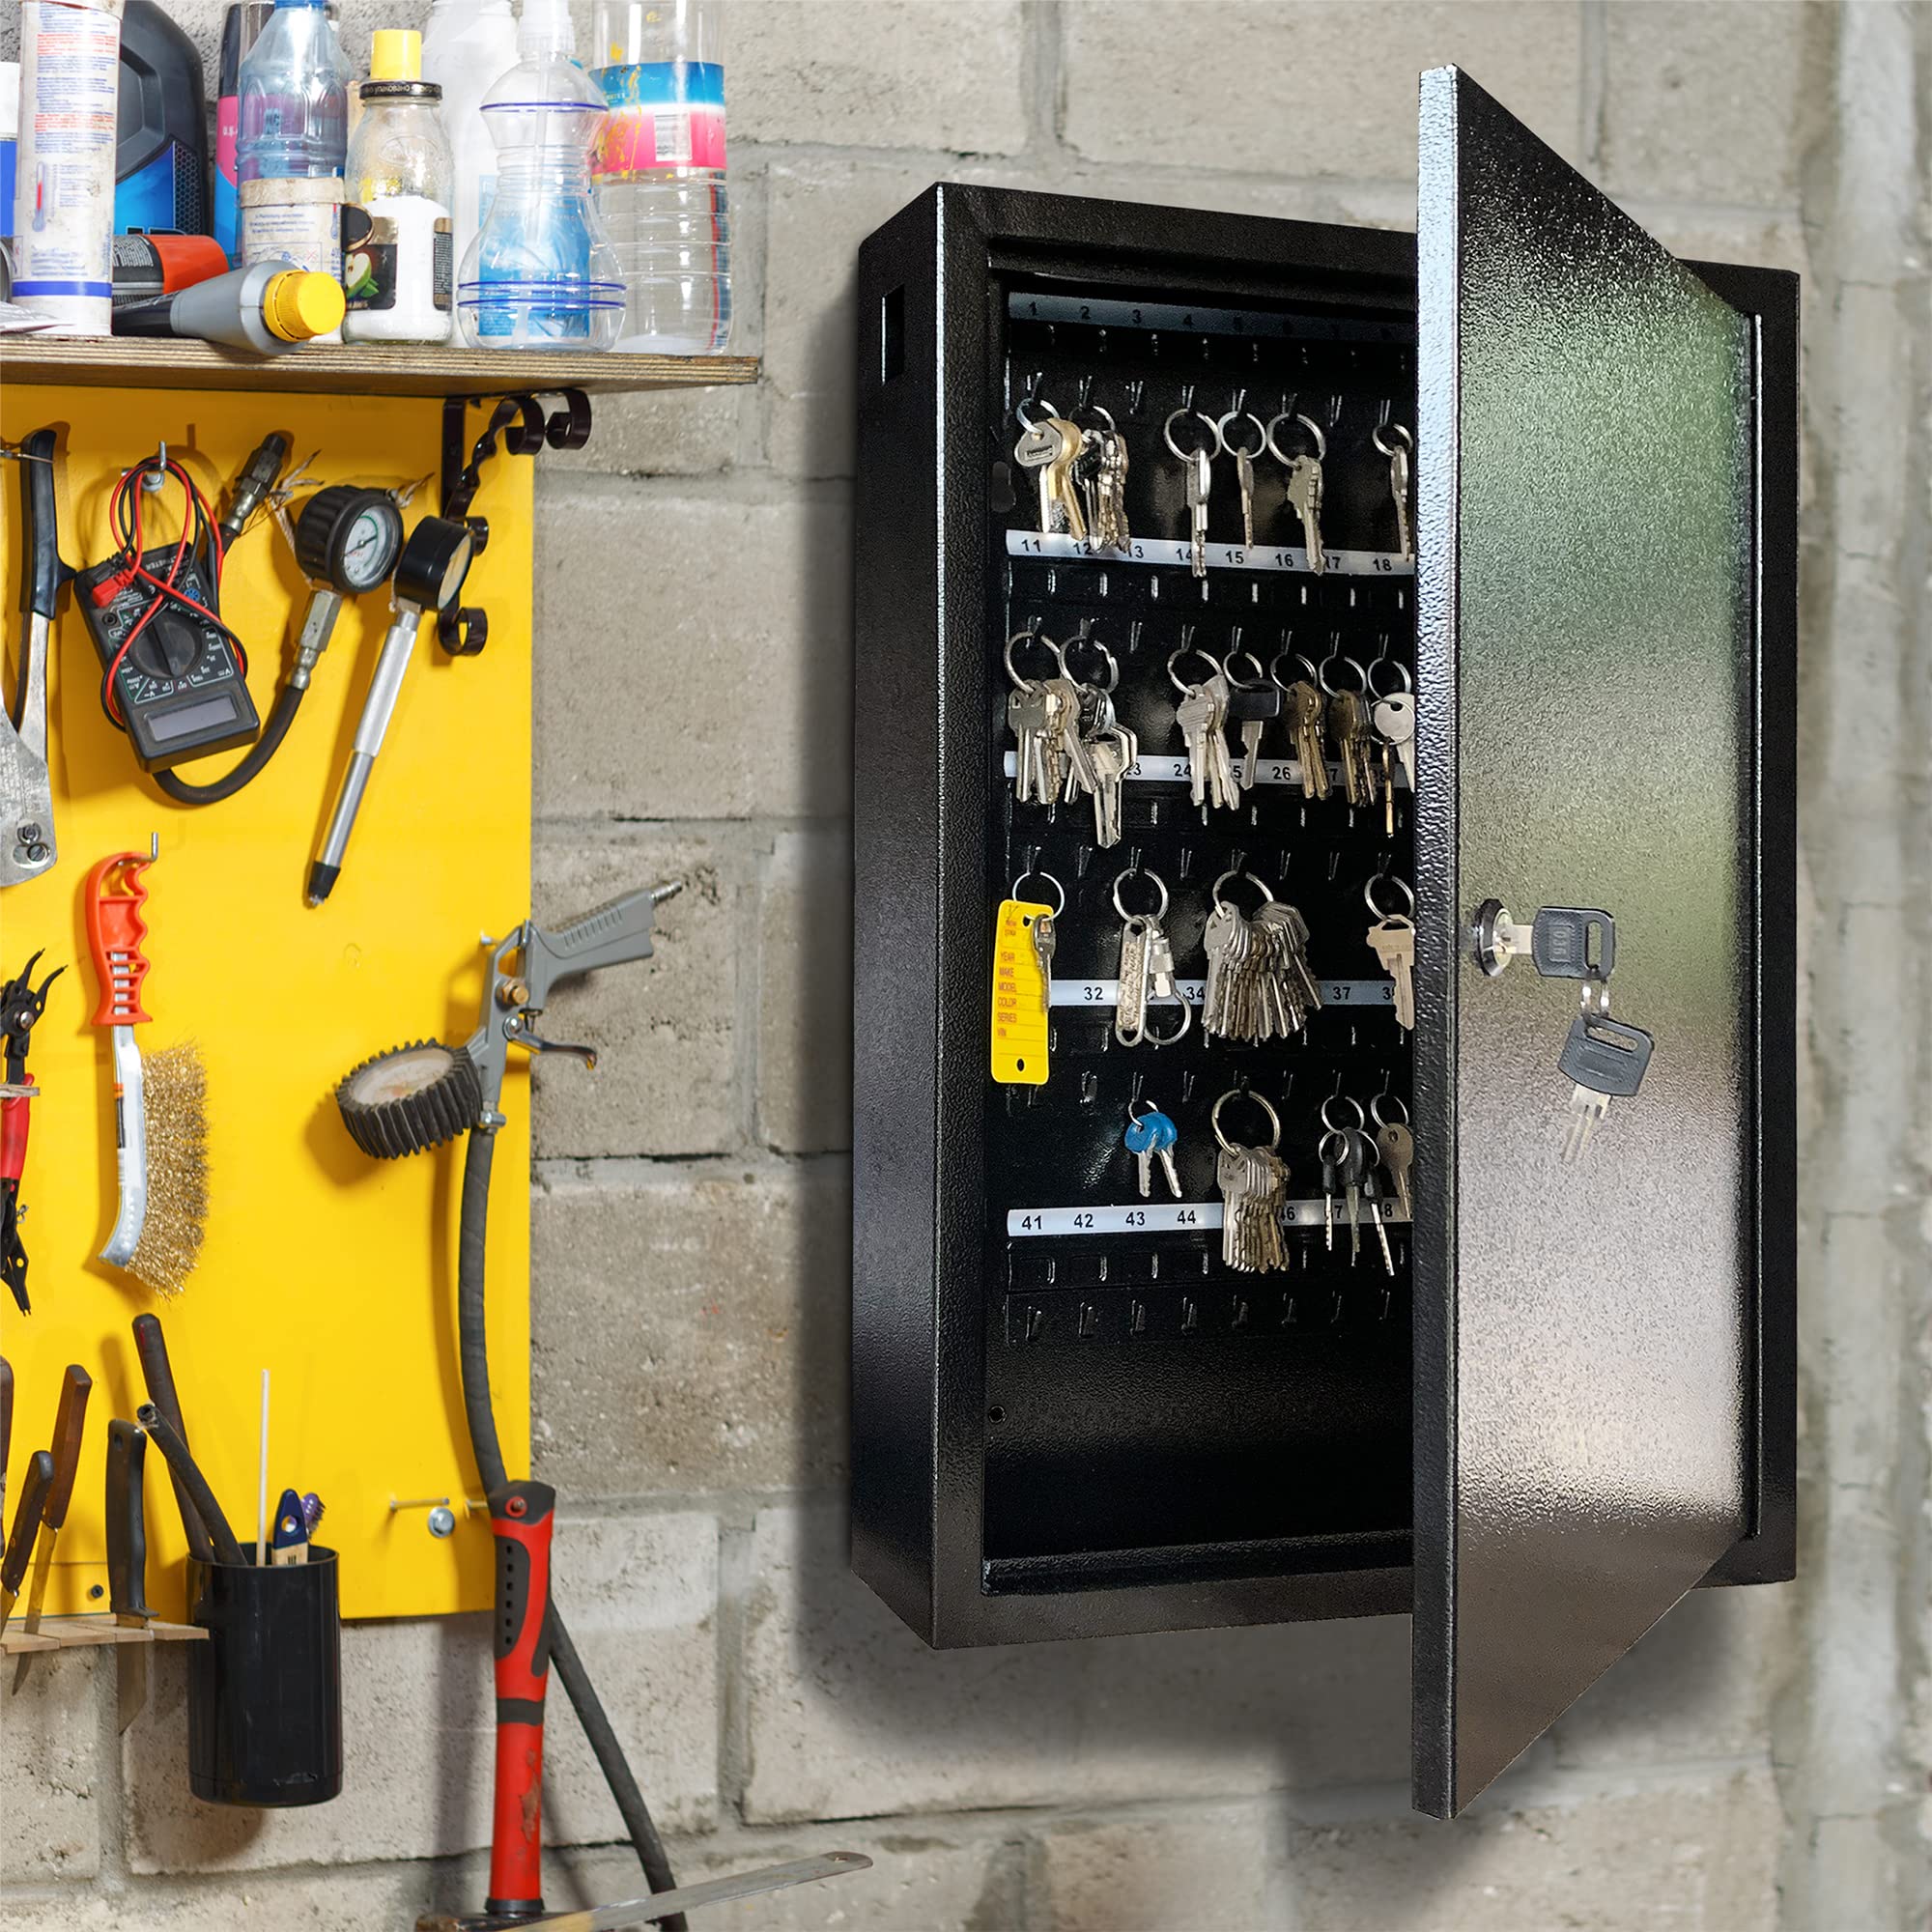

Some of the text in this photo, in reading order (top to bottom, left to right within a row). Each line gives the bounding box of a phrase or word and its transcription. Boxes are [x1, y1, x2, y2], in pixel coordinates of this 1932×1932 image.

[1029, 301, 1037, 316] 1
[1080, 305, 1091, 320] 2
[1132, 309, 1142, 325] 3
[1183, 314, 1193, 328] 4
[1022, 539, 1041, 553] 11
[1073, 542, 1093, 555] 12
[1225, 551, 1244, 564] 15
[1275, 554, 1293, 567] 16
[1373, 558, 1392, 572] 18
[1173, 763, 1192, 777] 24
[1271, 766, 1292, 781] 26
[1000, 952, 1014, 962] YEAR
[998, 982, 1016, 993] MODEL
[1084, 986, 1104, 1001] 32
[1186, 986, 1206, 1001] 34
[1332, 986, 1351, 1001] 37
[998, 997, 1016, 1008] COLOR
[997, 1011, 1017, 1023] SERIES
[1021, 1215, 1042, 1230] 41
[1073, 1213, 1094, 1228] 42
[1125, 1211, 1146, 1226] 43
[1177, 1209, 1197, 1224] 44
